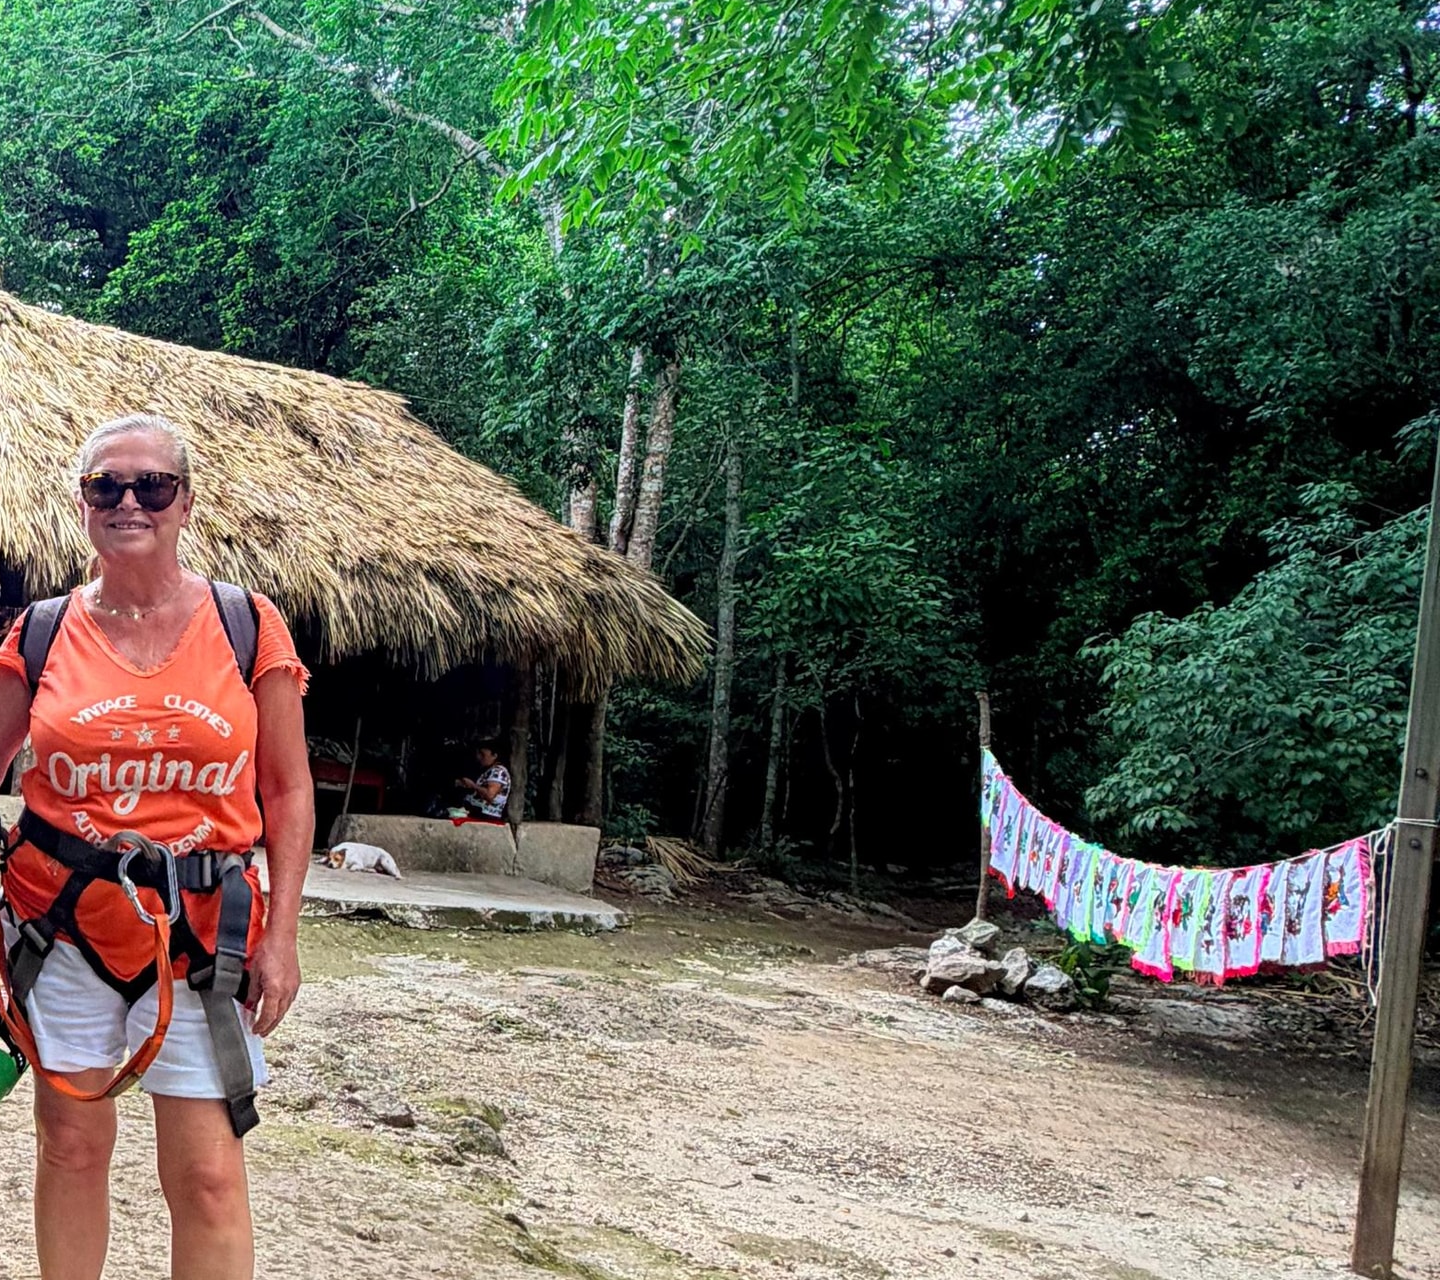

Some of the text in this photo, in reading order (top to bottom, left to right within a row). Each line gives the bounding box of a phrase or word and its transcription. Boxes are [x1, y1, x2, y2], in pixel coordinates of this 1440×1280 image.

[70, 694, 233, 737] VINTAGE CLOTHES
[48, 750, 249, 815] Original
[170, 816, 215, 856] DENIM
